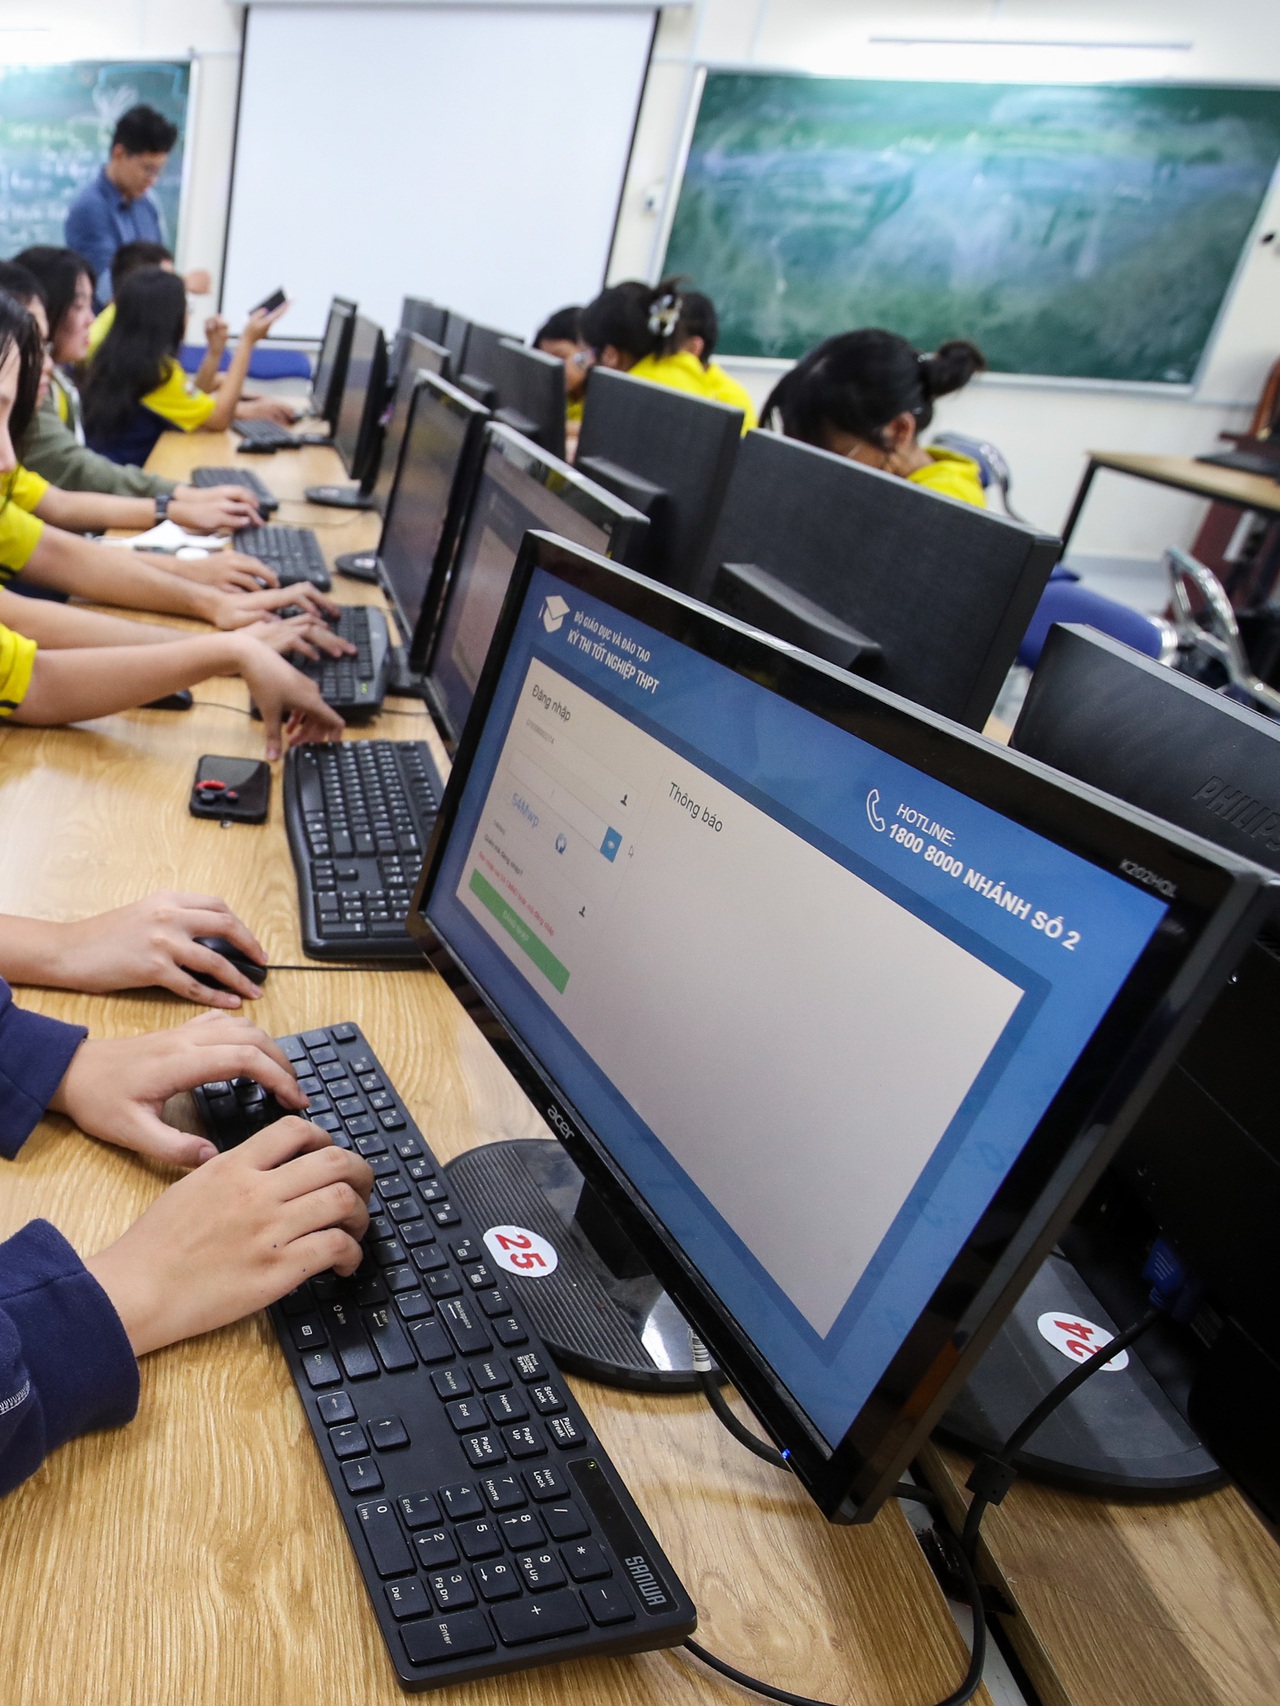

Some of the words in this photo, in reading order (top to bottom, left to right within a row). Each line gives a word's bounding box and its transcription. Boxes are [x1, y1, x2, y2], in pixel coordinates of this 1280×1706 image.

[574, 611, 584, 624] BỘ
[583, 616, 598, 632] GIÁO
[598, 625, 611, 639] DỤC
[612, 632, 621, 646] VÀ
[621, 637, 636, 654] ĐÀO
[636, 646, 650, 662] TẠO
[567, 629, 579, 645] KỲ
[579, 635, 592, 653] THI
[591, 642, 607, 662] TỐT
[605, 652, 635, 679] NGHIỆP
[635, 670, 659, 694] THPT
[532, 684, 551, 709] Đăng
[551, 700, 571, 722] nhập
[669, 782, 700, 819] Thông
[701, 805, 724, 832] báo
[896, 803, 956, 847] HOTLINE:
[889, 823, 924, 854] 1800
[924, 845, 964, 878] 8000
[963, 868, 1032, 920] NHÁNH
[1031, 910, 1064, 939] SỐ
[1062, 931, 1081, 951] 2
[547, 1104, 575, 1139] acer
[495, 1233, 547, 1269] 25
[477, 1265, 486, 1275] F10
[492, 1291, 502, 1302] F11
[453, 1301, 472, 1329] Backspace
[507, 1319, 518, 1330] F12
[444, 1371, 457, 1390] Delete
[483, 1363, 496, 1380] Insert
[499, 1394, 512, 1413] Home
[535, 1388, 546, 1403] Lock
[544, 1386, 559, 1404] Scroll
[459, 1404, 470, 1417] End
[512, 1430, 521, 1440] Up
[552, 1420, 565, 1438] Break
[562, 1417, 576, 1436] Pause
[481, 1436, 493, 1454] Page
[522, 1427, 535, 1445] Page
[470, 1439, 484, 1458] Down
[502, 1476, 514, 1484] 7
[533, 1470, 546, 1489] Lock
[542, 1468, 556, 1486] Num
[460, 1486, 471, 1495] 4
[485, 1479, 500, 1501] Home
[376, 1505, 388, 1513] 0
[402, 1498, 414, 1514] End
[520, 1514, 532, 1523] 8
[433, 1533, 445, 1541] 2
[476, 1524, 488, 1532] 5
[539, 1555, 551, 1563] 9
[494, 1565, 507, 1573] 6
[450, 1574, 463, 1584] 3
[624, 1555, 667, 1606] SANWA
[391, 1586, 402, 1601] Del
[438, 1623, 453, 1645] Enter
